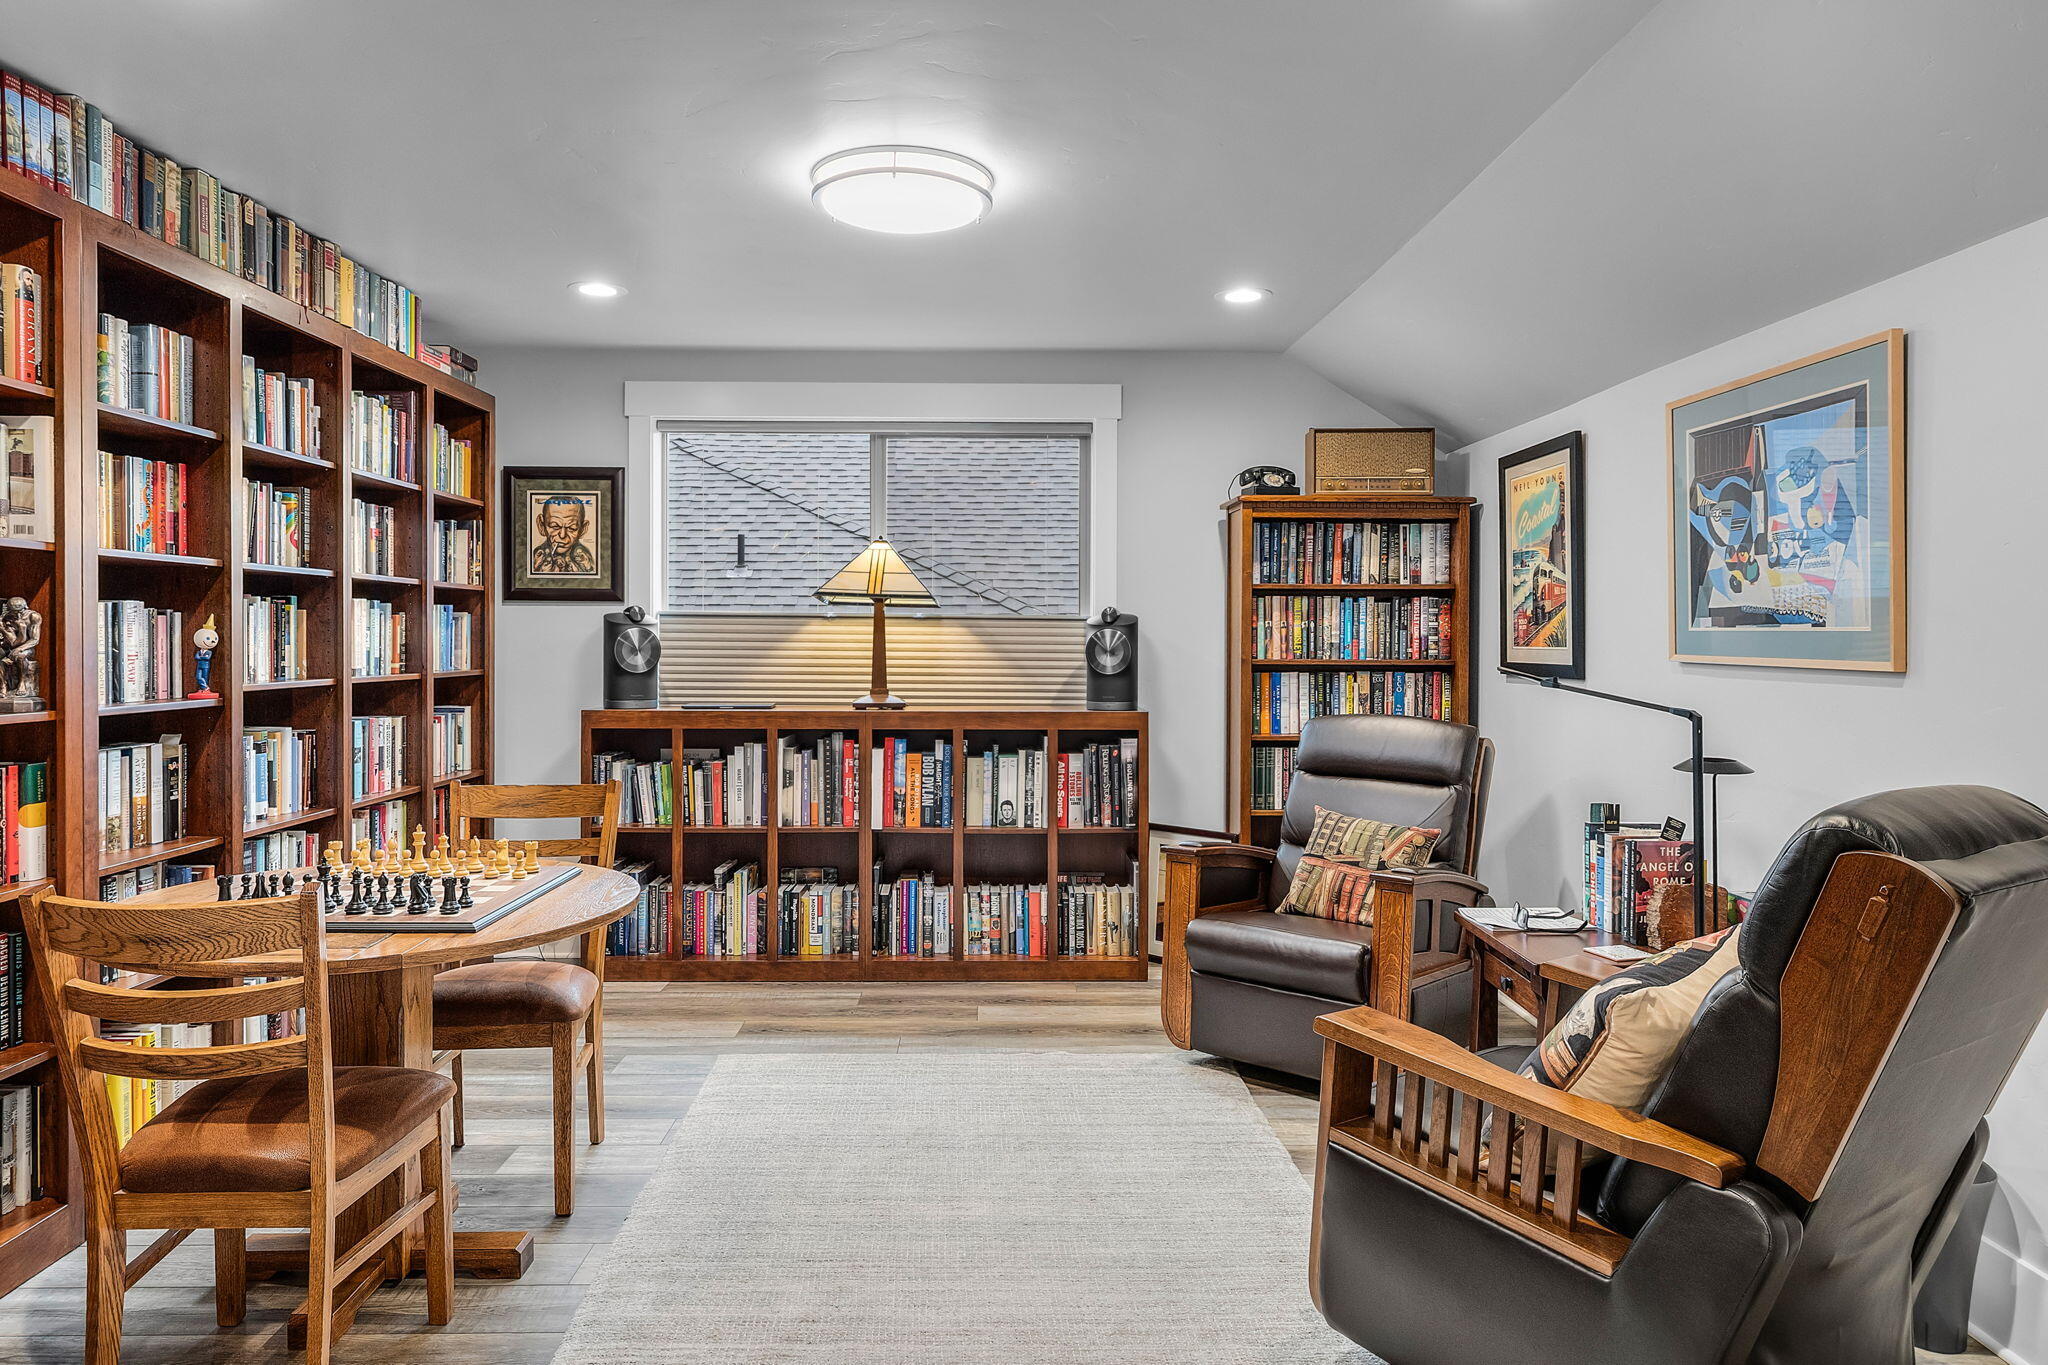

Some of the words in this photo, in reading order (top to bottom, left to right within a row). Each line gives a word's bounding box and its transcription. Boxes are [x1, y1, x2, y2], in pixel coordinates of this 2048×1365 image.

[27, 308, 35, 365] GRANT
[1514, 481, 1531, 493] NEIL
[1535, 471, 1564, 488] YOUNG
[1518, 488, 1558, 538] Coastal
[127, 605, 138, 637] William
[1293, 598, 1301, 624] WALTER
[1293, 627, 1302, 654] MOSLEY
[127, 652, 138, 684] Trevor
[135, 758, 141, 769] AT
[141, 758, 146, 769] AN
[922, 756, 934, 775] BOB
[1102, 750, 1110, 776] ROLLING
[922, 777, 934, 806] DYLAN
[1057, 790, 1065, 818] Songs
[1102, 784, 1111, 806] STONES
[1660, 847, 1681, 856] THE
[1639, 862, 1679, 872] ANGEL
[1684, 862, 1694, 872] O
[1653, 877, 1686, 886] ROME
[991, 896, 999, 916] MONK
[1098, 897, 1107, 946] SINATRA
[1076, 930, 1085, 949] TOSCHES
[0, 939, 8, 970] SACRED
[0, 976, 8, 1007] DENNIS
[0, 1008, 8, 1041] LEHANE
